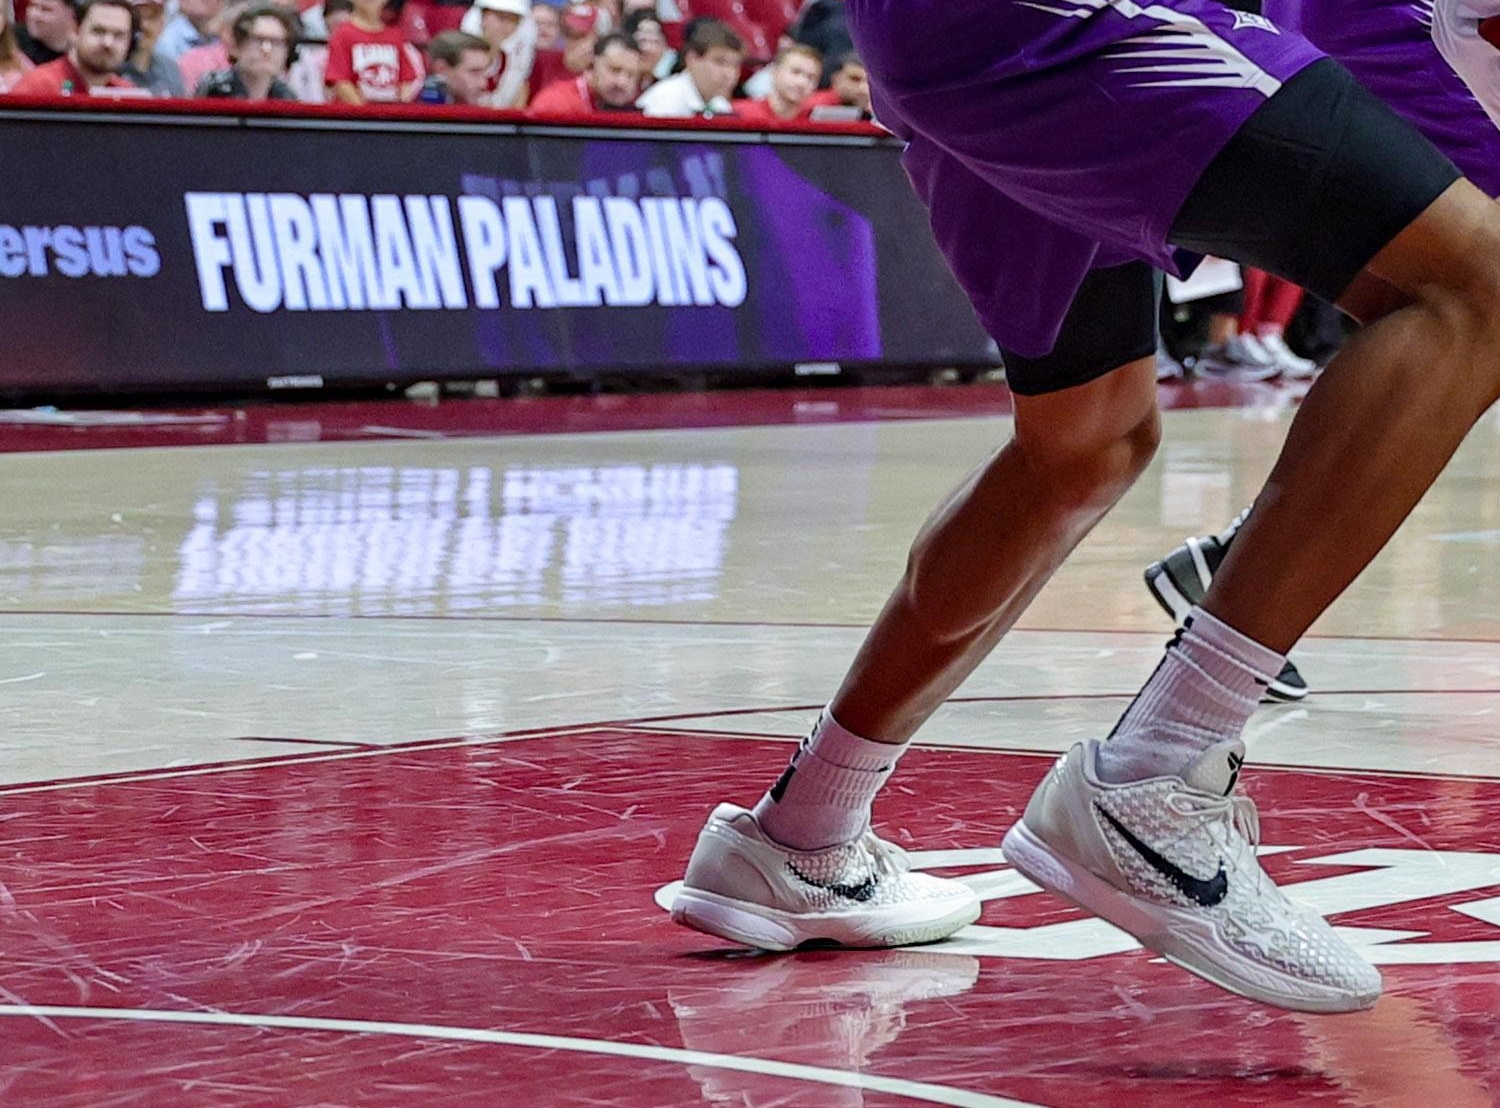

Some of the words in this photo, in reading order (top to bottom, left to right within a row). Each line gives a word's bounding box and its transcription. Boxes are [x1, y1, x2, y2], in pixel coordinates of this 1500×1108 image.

[0, 224, 161, 278] ersus
[184, 192, 468, 313] FURMAN
[457, 194, 748, 309] PALADINS
